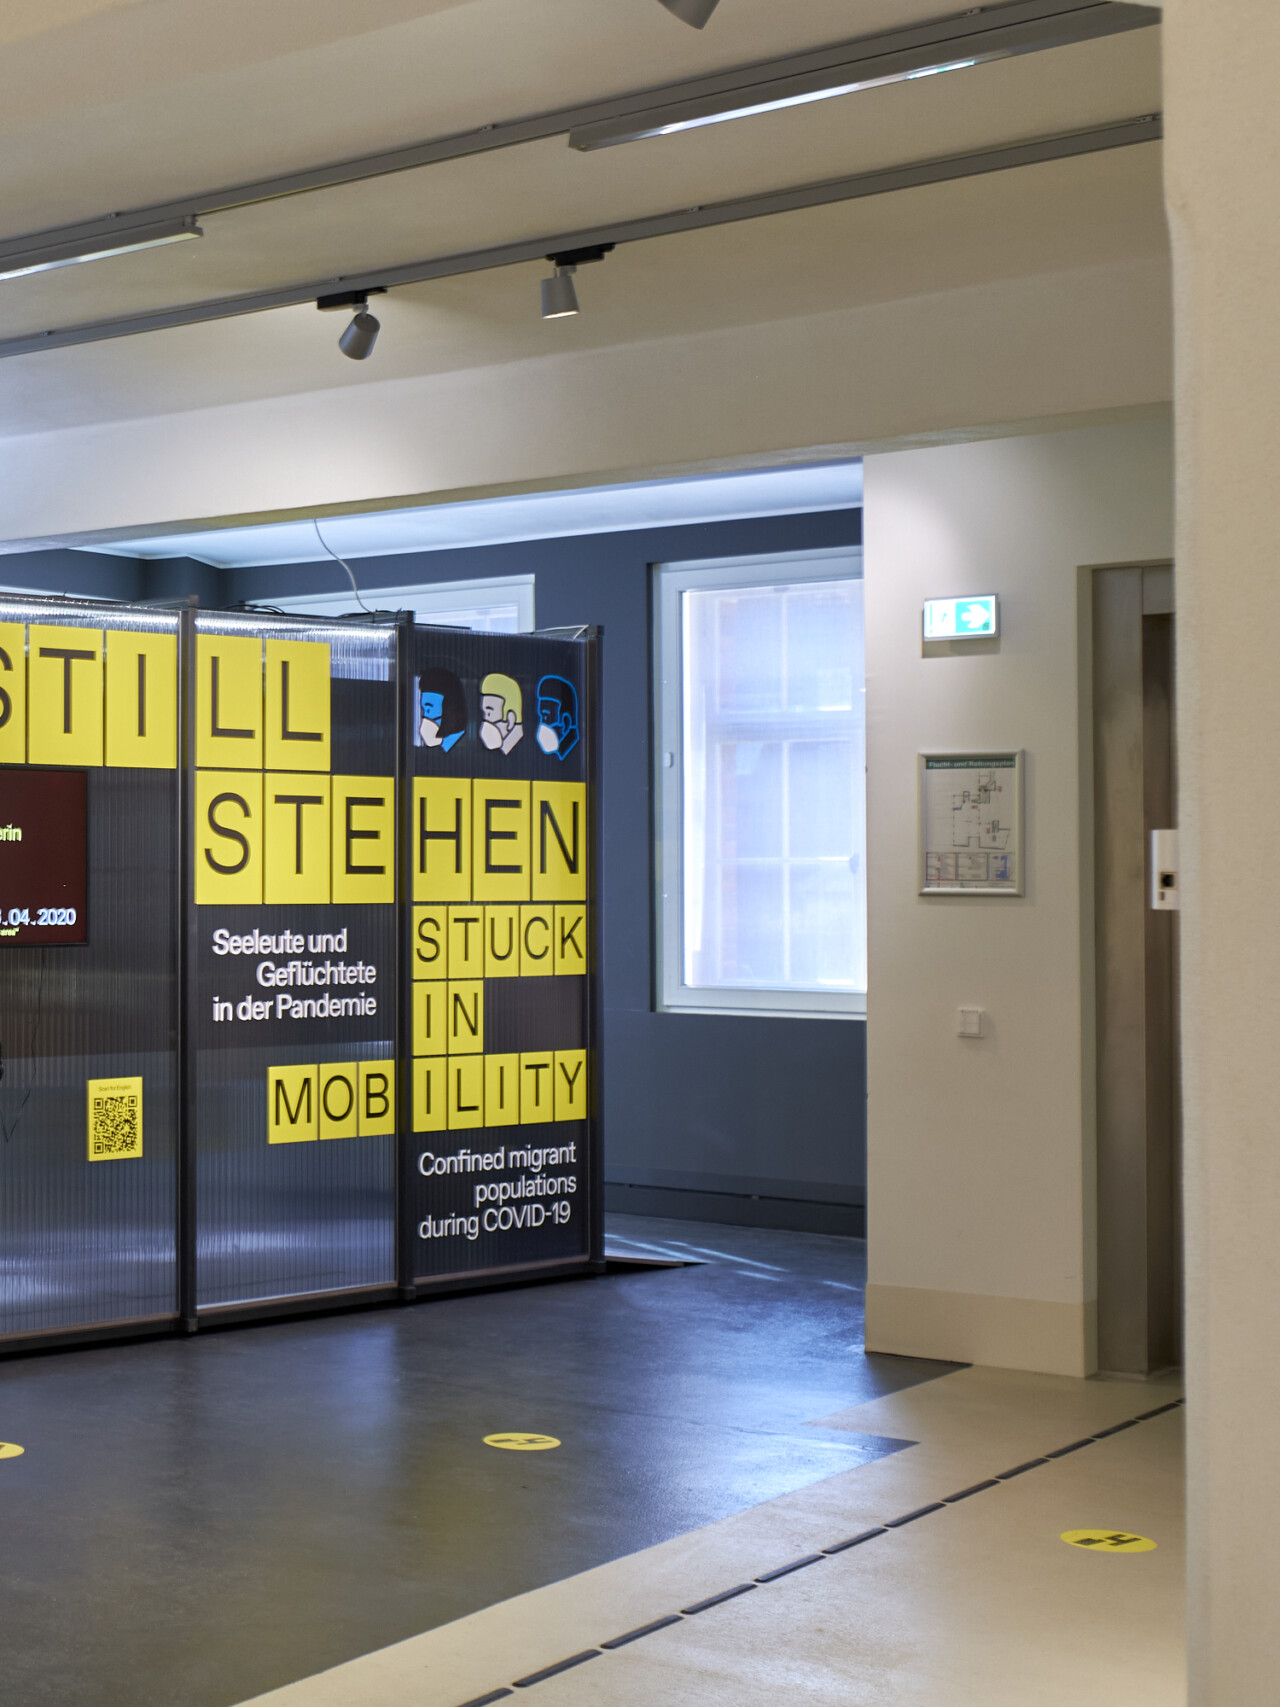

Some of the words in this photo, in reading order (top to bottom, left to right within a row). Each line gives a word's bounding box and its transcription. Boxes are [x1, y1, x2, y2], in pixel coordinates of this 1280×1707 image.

[203, 790, 579, 876] STEHEN
[212, 929, 304, 957] Seeleute
[307, 928, 347, 955] und
[415, 914, 583, 963] STUCK
[257, 960, 376, 988] Geflüchtete
[212, 996, 234, 1023] in
[237, 995, 273, 1021] der
[276, 991, 376, 1019] Pandemie
[422, 991, 480, 1039] IN
[275, 1061, 584, 1127] MOBILITY
[418, 1149, 505, 1176] Confined
[508, 1143, 577, 1174] migrant
[475, 1175, 577, 1208] populations
[418, 1211, 480, 1242] during
[483, 1201, 572, 1230] COVID-19
